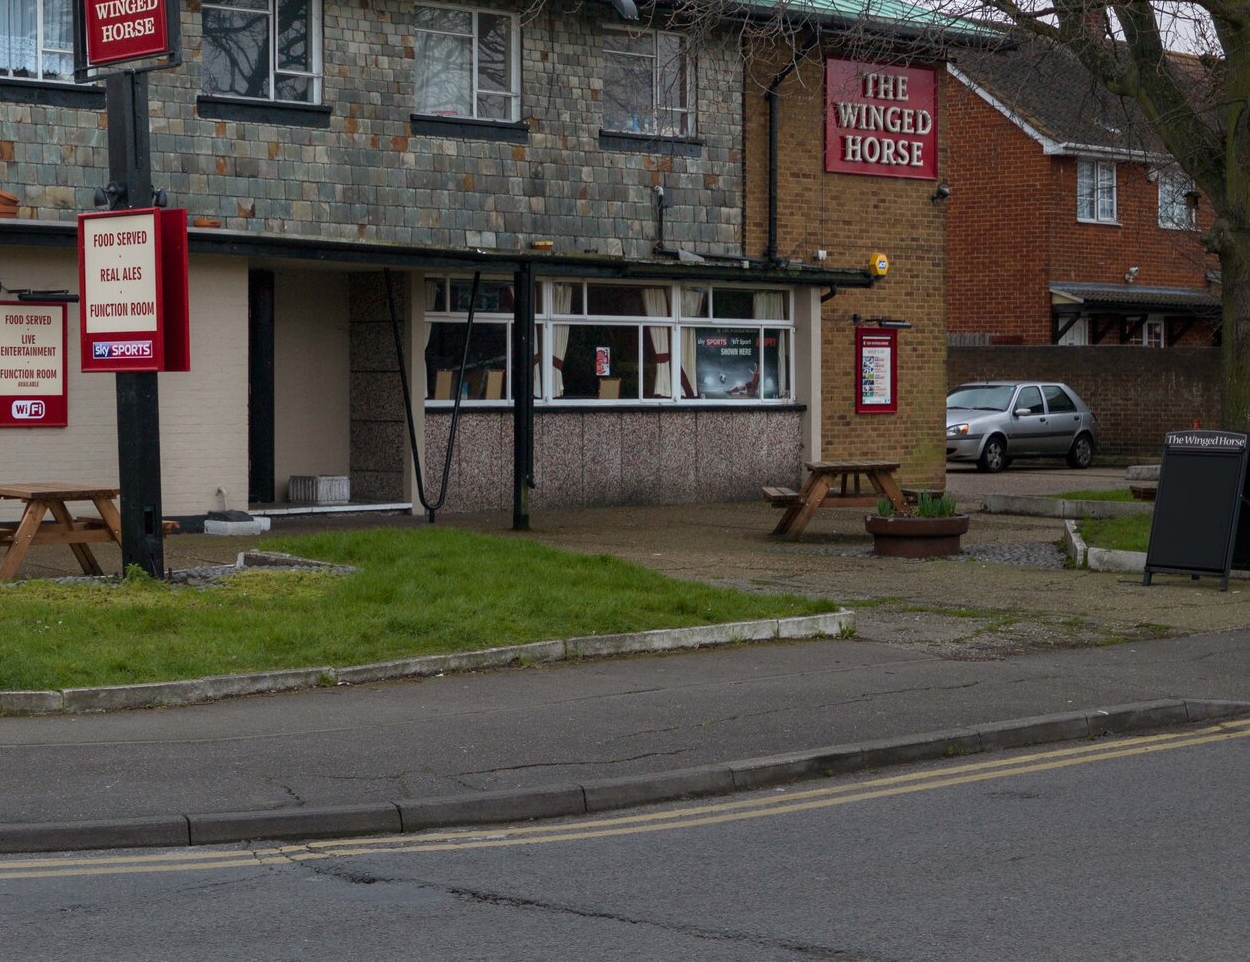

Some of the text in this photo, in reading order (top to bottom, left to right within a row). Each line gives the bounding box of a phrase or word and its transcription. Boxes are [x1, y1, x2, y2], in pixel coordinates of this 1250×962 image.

[101, 17, 155, 43] HORSE
[862, 72, 909, 101] THE
[837, 101, 932, 135] WINGED
[844, 135, 924, 167] HORSE
[93, 230, 147, 247] FOOD SERVED
[100, 266, 142, 282] REAL ALES
[90, 301, 155, 318] FUNCTION ROOM
[5, 315, 52, 325] FOOD SERVED
[21, 335, 36, 345] LIVE
[706, 338, 728, 346] SPORTS
[0, 346, 56, 357] ENTERTAINMENT
[95, 343, 151, 357] sky SPORTS
[720, 348, 752, 356] SHOWN HERE
[0, 369, 57, 379] FUNCTION ROOM
[1168, 435, 1245, 447] The Winged Horse
